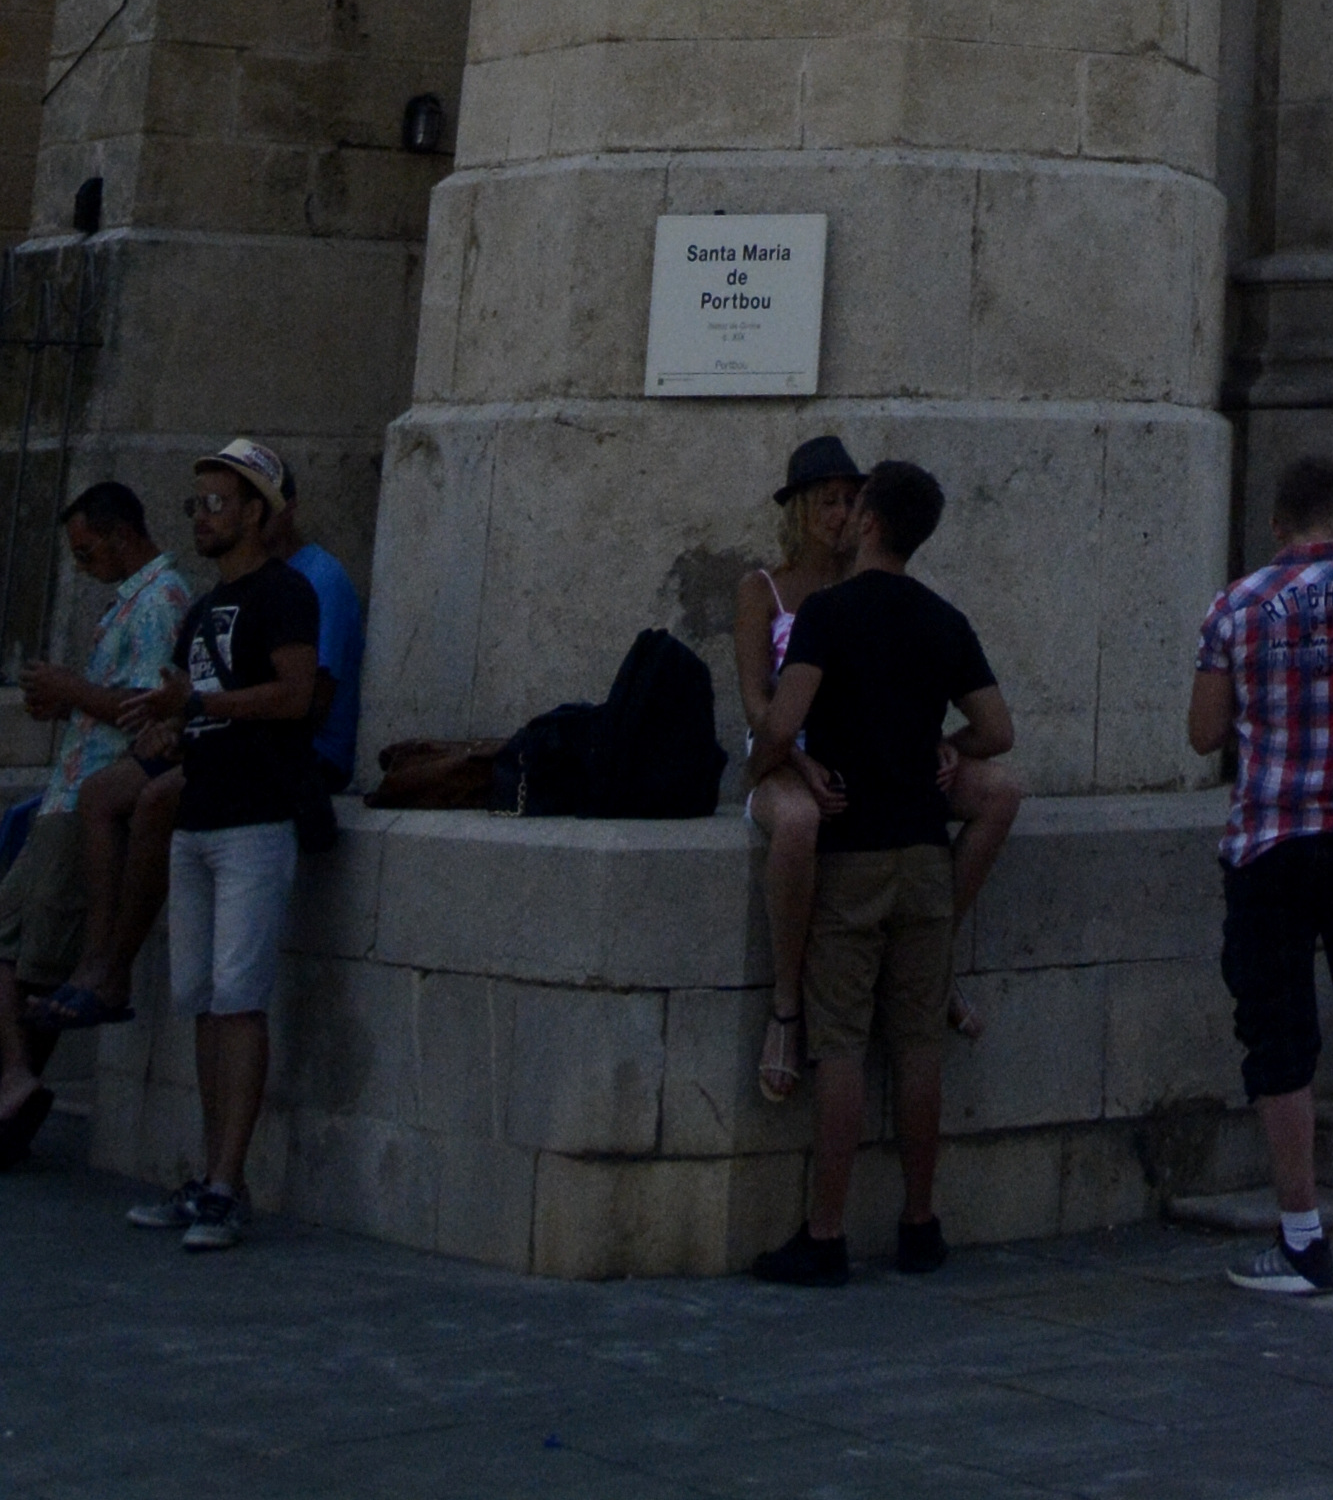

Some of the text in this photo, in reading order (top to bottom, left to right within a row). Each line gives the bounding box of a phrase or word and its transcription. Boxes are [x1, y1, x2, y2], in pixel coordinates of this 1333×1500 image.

[687, 243, 791, 262] Santa Maria
[726, 269, 748, 286] de
[700, 292, 771, 310] Portbou
